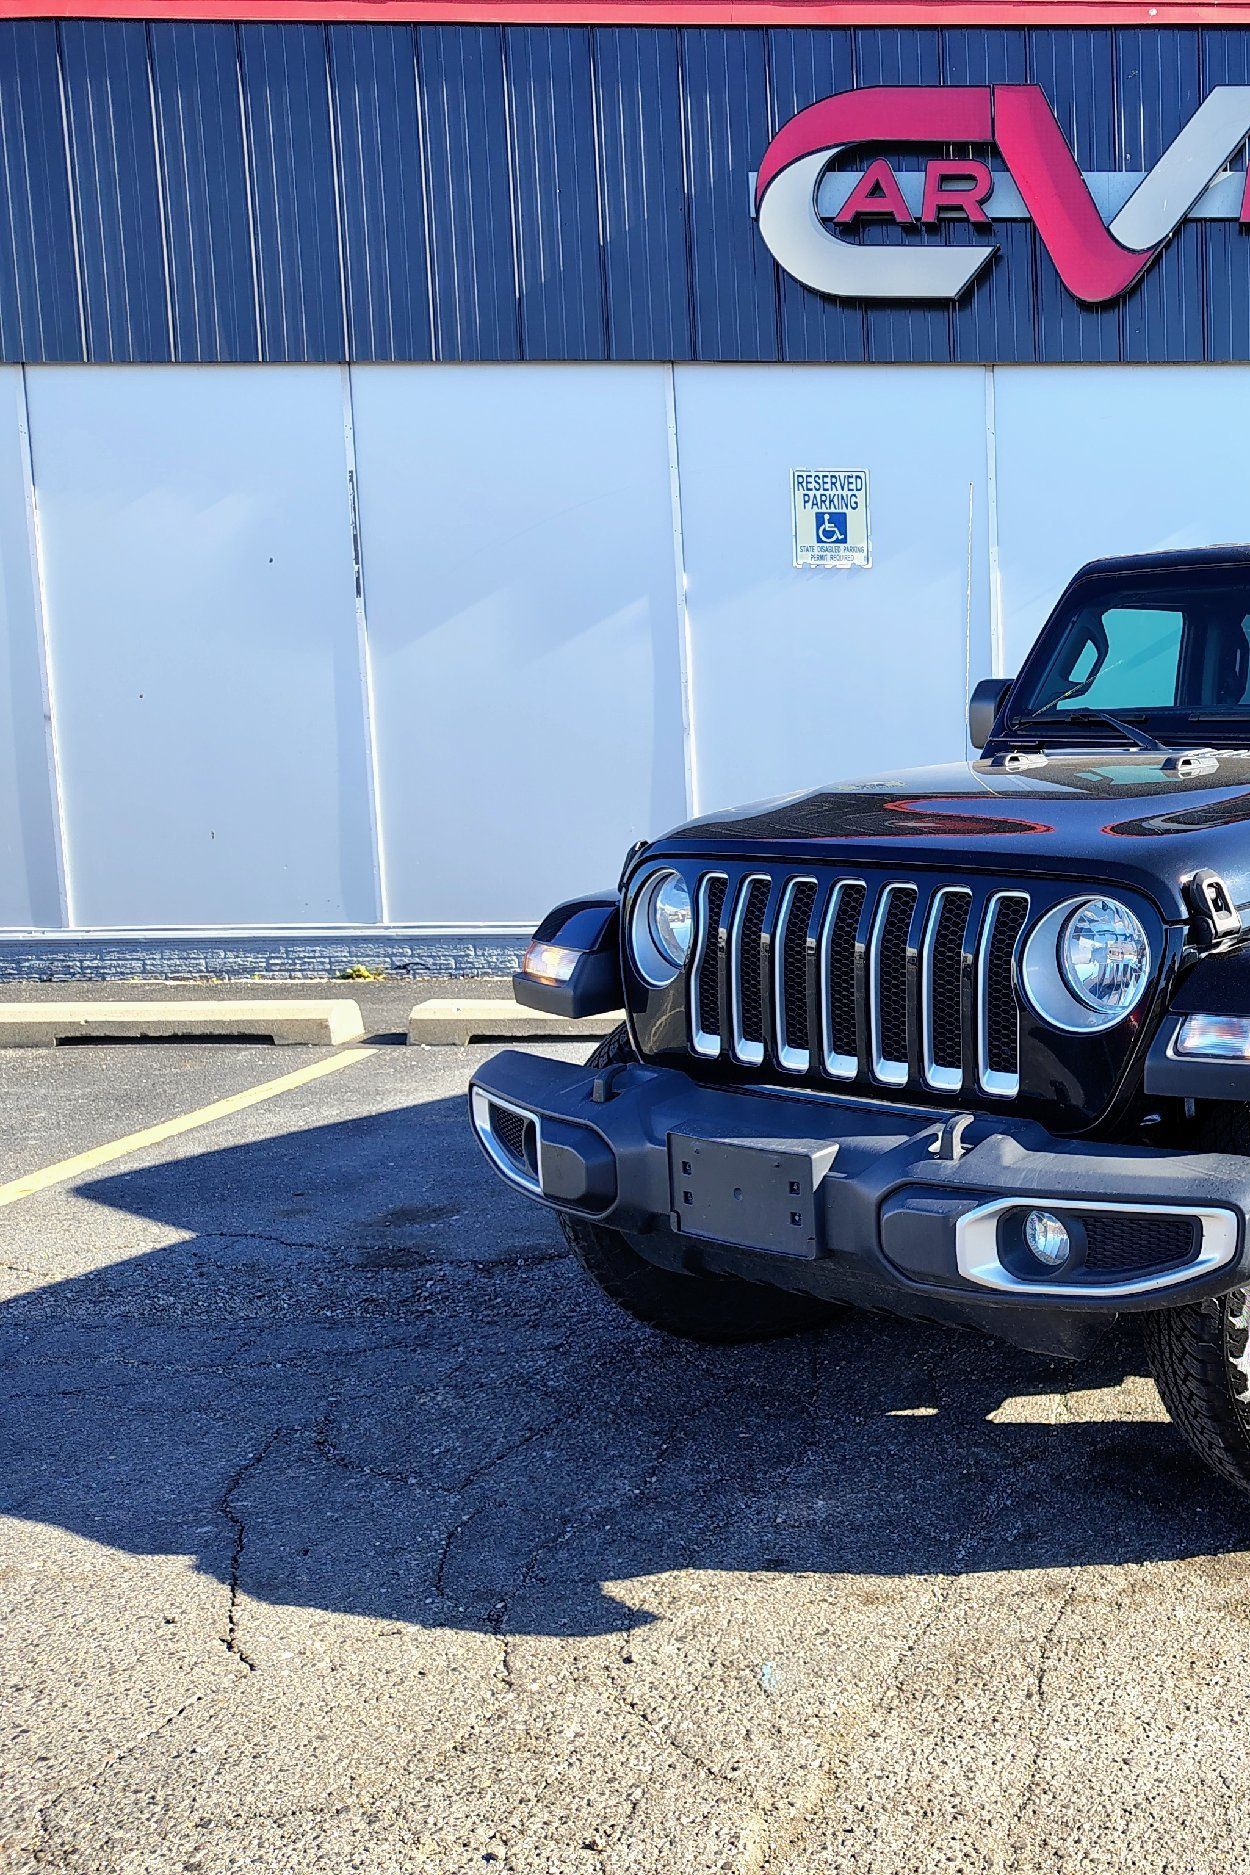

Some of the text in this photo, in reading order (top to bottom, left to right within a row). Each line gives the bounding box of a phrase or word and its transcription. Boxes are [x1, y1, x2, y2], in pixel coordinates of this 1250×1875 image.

[796, 474, 863, 491] RESERVED
[802, 493, 859, 510] PARKING
[800, 545, 865, 554] STATE DISABLED PARKING
[810, 554, 855, 562] PERMIT REQUIRED
